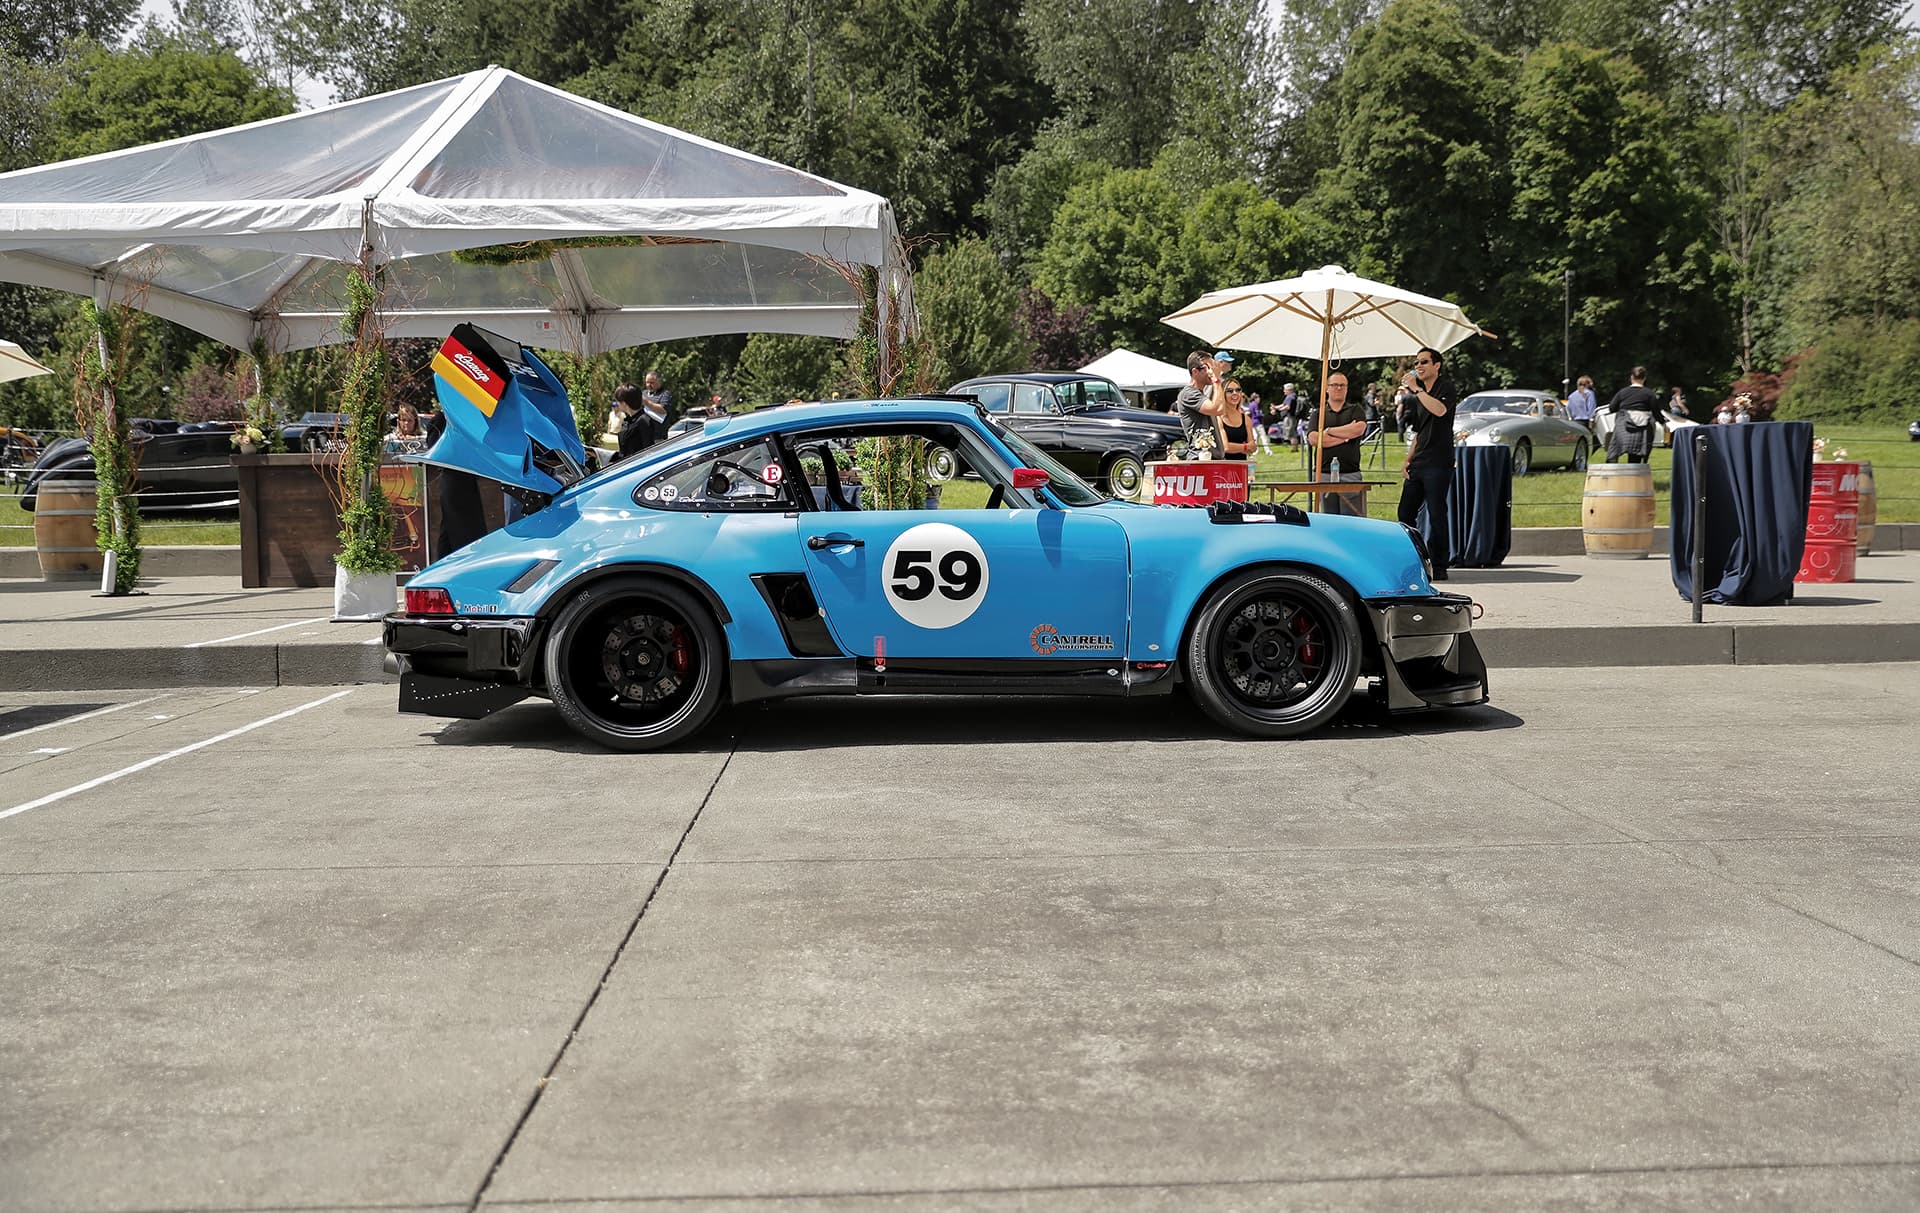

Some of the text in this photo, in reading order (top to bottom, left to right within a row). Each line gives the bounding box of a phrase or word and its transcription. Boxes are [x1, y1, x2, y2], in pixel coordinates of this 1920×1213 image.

[767, 467, 778, 480] E
[1154, 476, 1208, 496] OTUL
[663, 488, 675, 496] 59
[891, 550, 982, 601] 59
[464, 605, 489, 613] Mobil
[1041, 635, 1113, 645] CANTRELL
